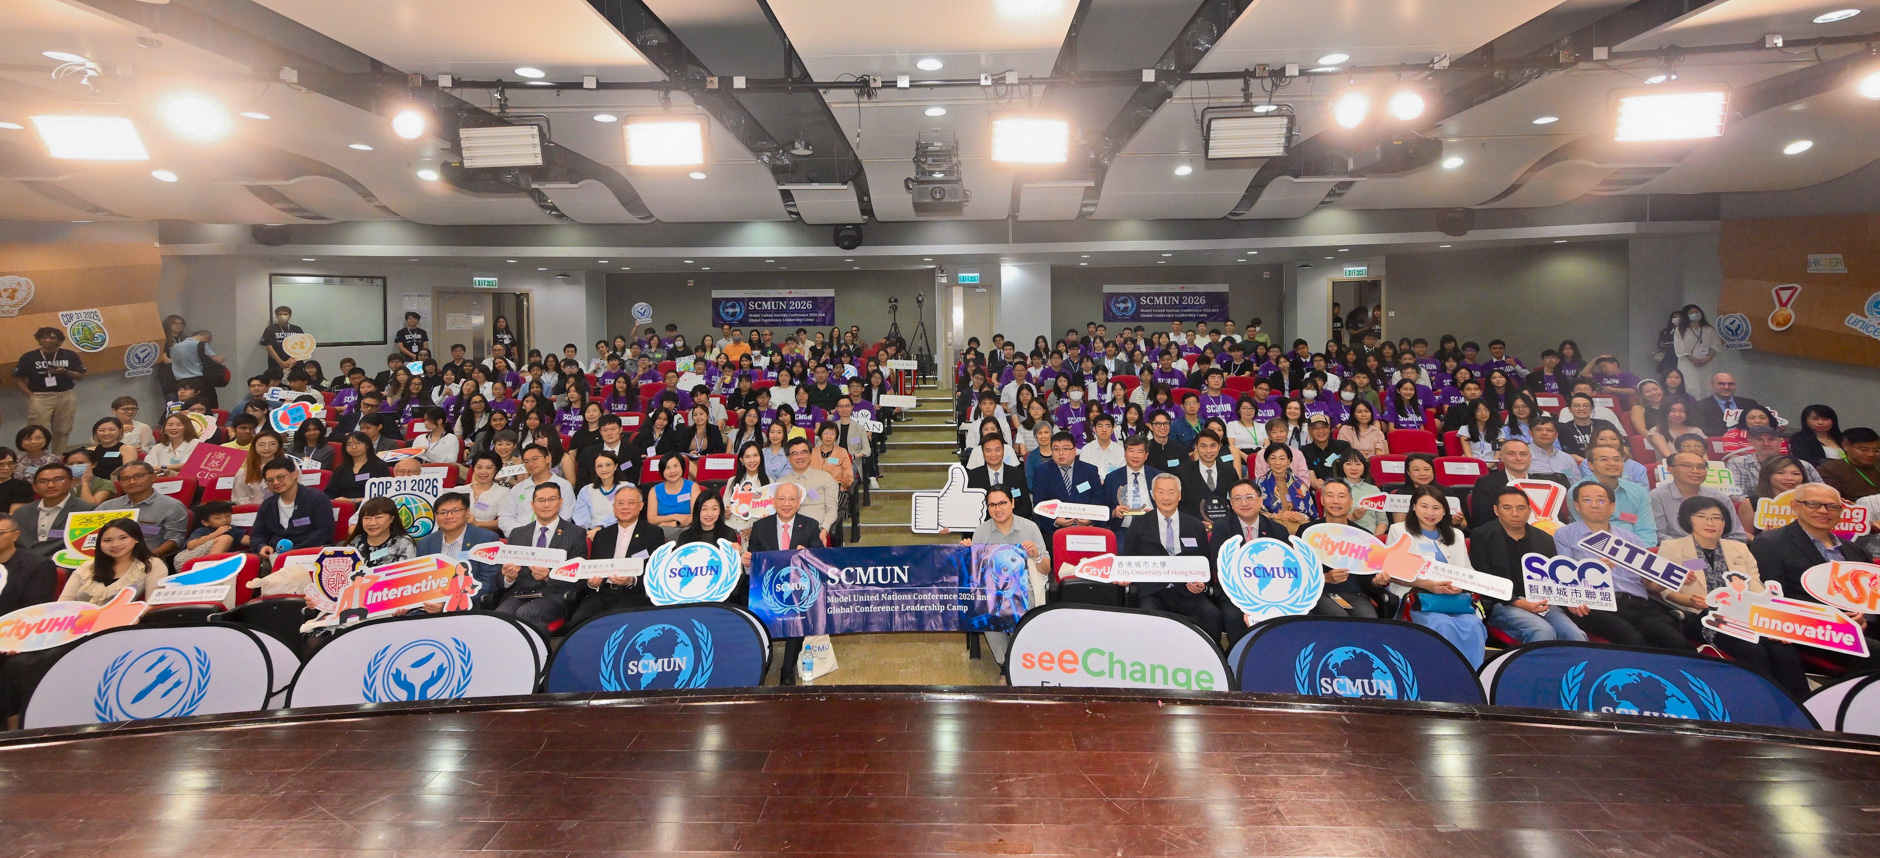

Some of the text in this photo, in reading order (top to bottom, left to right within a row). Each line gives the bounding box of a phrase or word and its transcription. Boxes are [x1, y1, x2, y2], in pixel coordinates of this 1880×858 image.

[748, 300, 812, 310] SCMUN 2026
[1140, 295, 1206, 305] SCMUN 2026
[61, 310, 102, 326] COP 31 2026
[1846, 315, 1880, 337] unice
[127, 369, 152, 377] SOCHUM
[196, 470, 218, 480] CIS
[369, 478, 439, 499] COP 31 2026
[1362, 500, 1385, 510] CityU
[1760, 515, 1787, 526] into
[476, 550, 497, 559] CityU
[1309, 532, 1373, 562] CityUHK
[1117, 561, 1167, 569] 香港城市大學
[1583, 531, 1688, 587] AiTLE
[557, 568, 577, 576] CityU
[668, 565, 720, 579] SCMUN
[826, 565, 910, 585] SCMUN
[1083, 565, 1111, 577] CityU
[1131, 569, 1163, 577] University
[1243, 566, 1299, 579] SCMUN
[1433, 565, 1475, 580] 香港城市大學
[1524, 556, 1610, 590] SCC
[775, 581, 809, 593] SCMUN
[1431, 570, 1443, 578] City
[1443, 573, 1470, 585] University
[1476, 582, 1491, 591] Hong
[1491, 585, 1506, 594] Kong
[366, 575, 449, 605] Interactive
[1528, 583, 1612, 602] 智慧城市聯盟
[826, 592, 992, 604] Model United Nations Conference 2026 and
[1529, 593, 1614, 608] Smart City Consortium
[826, 602, 969, 615] Global Conference Leadership Camp
[0, 614, 84, 640] CityUHK
[1752, 612, 1856, 646] Innovative
[627, 656, 688, 675] SCMUN
[1021, 647, 1215, 691] seeChange
[1320, 677, 1393, 697] SCMUN
